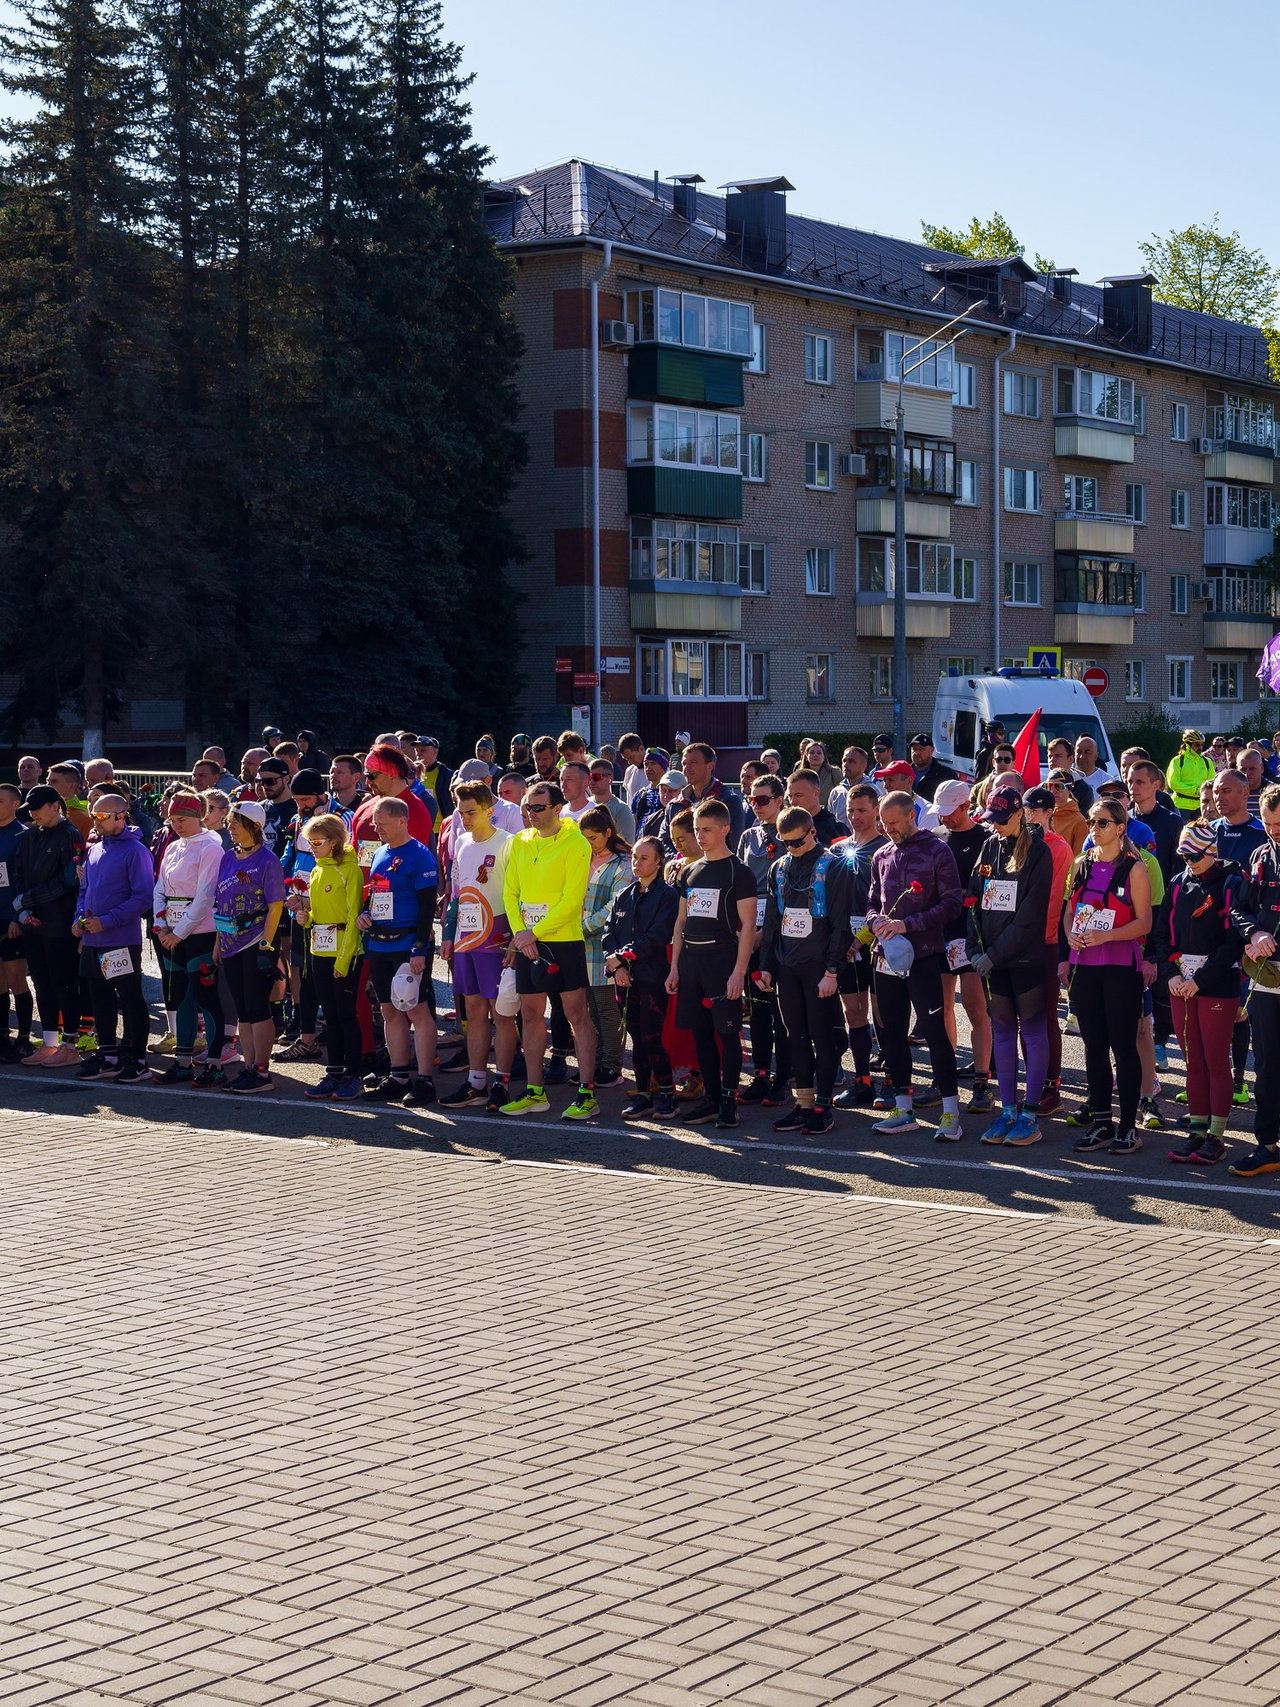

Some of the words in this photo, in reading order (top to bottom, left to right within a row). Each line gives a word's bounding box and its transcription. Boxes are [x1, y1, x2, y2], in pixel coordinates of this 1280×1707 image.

[999, 893, 1011, 901] 64
[376, 904, 389, 912] 159
[701, 901, 712, 909] 99
[794, 921, 806, 929] 45
[1093, 920, 1109, 930] 150
[320, 936, 333, 944] 176
[112, 959, 128, 968] 160
